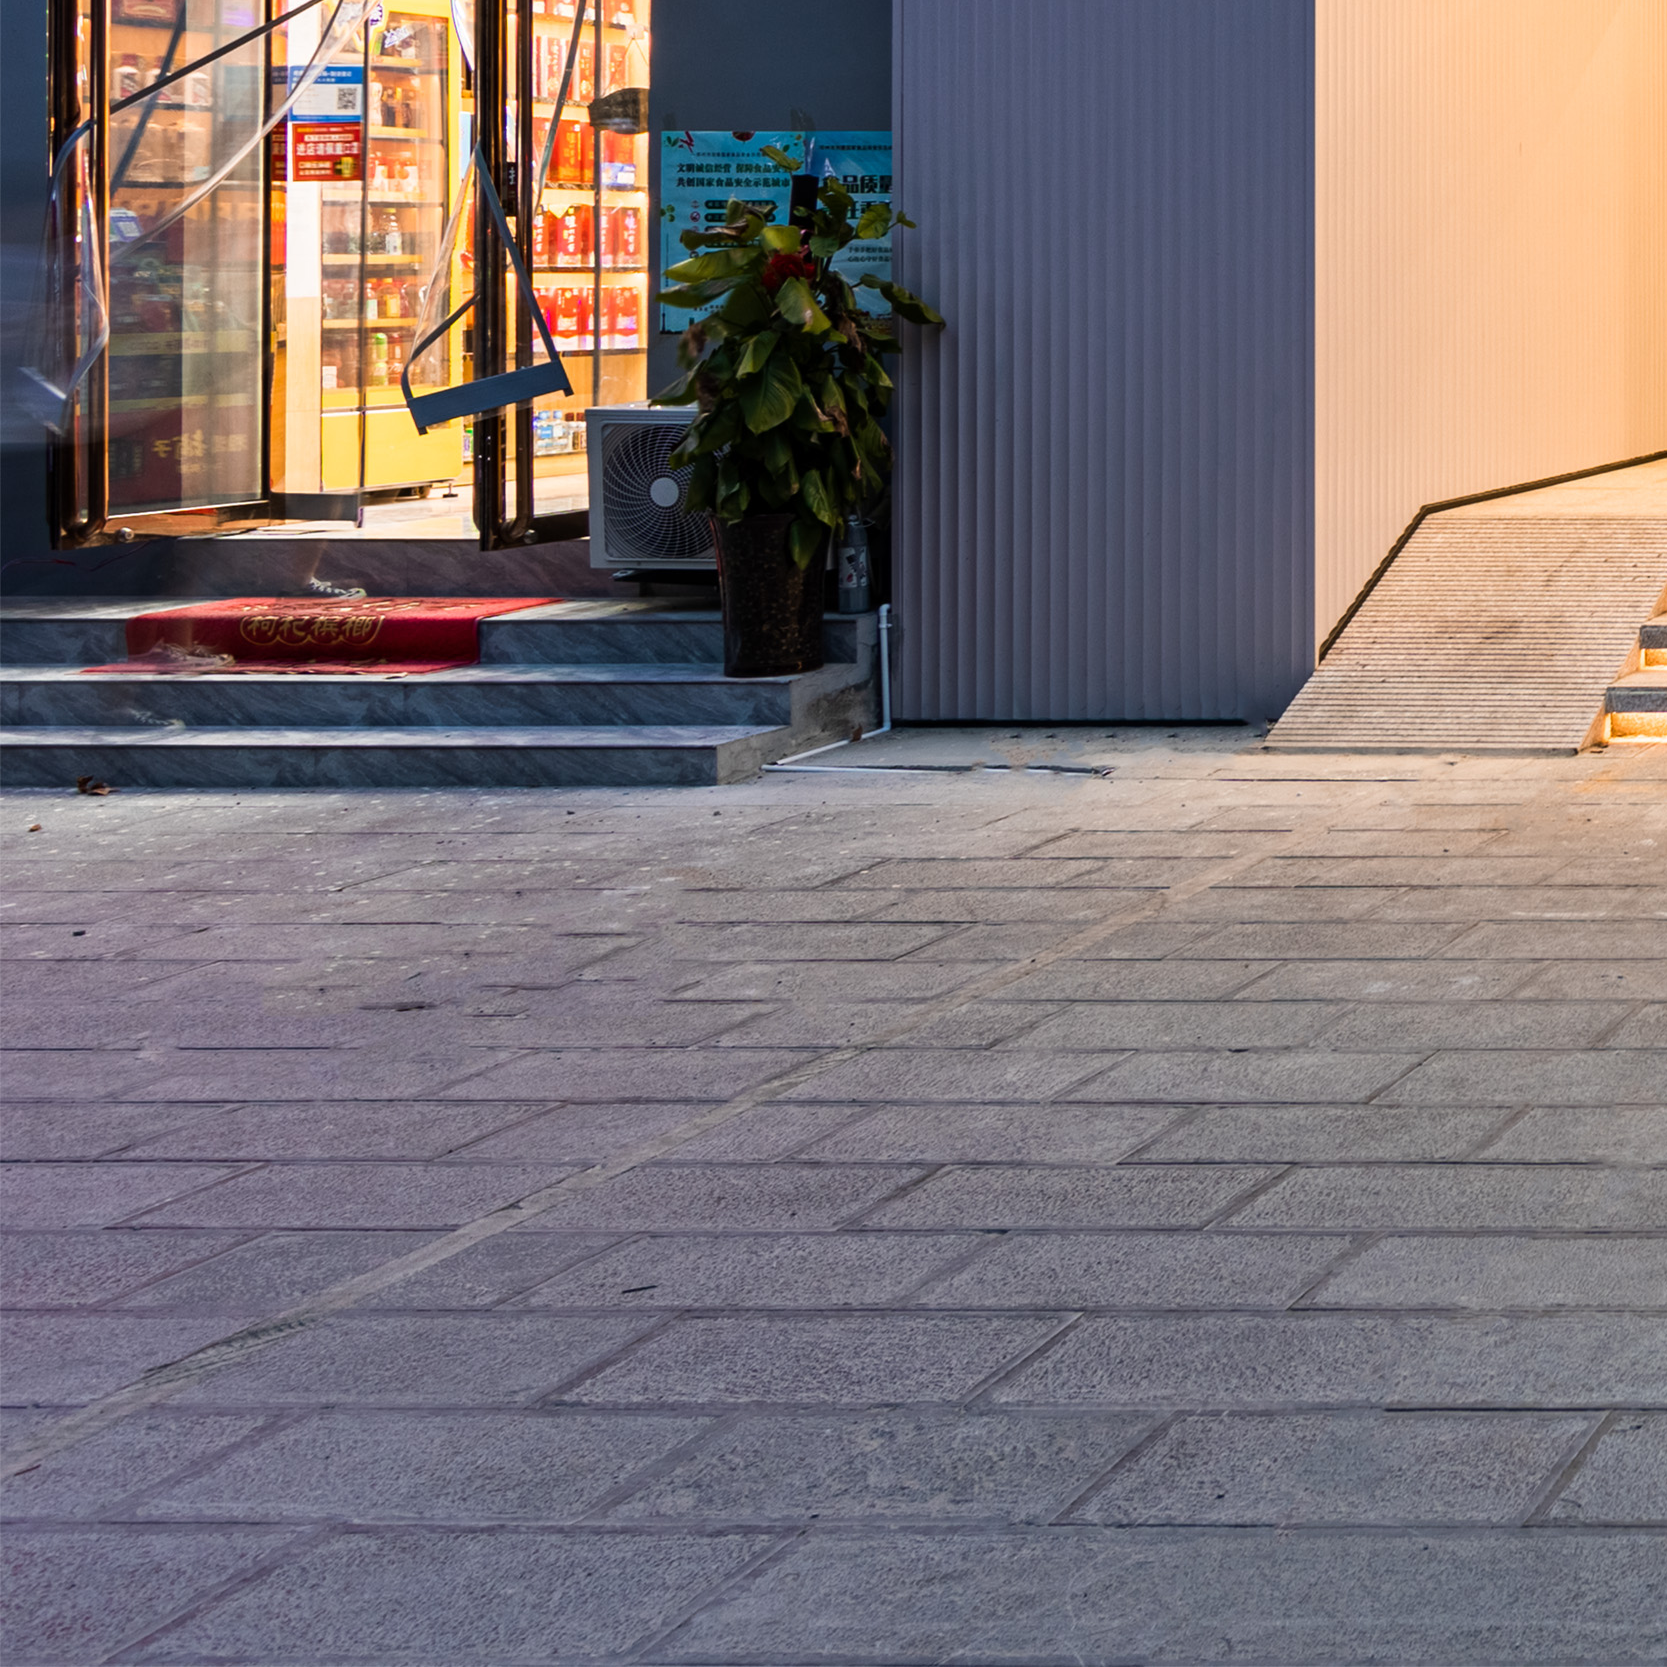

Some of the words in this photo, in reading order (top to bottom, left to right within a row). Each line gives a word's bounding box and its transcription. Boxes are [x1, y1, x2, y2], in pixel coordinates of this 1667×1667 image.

[736, 163, 790, 174] 保障食品安
